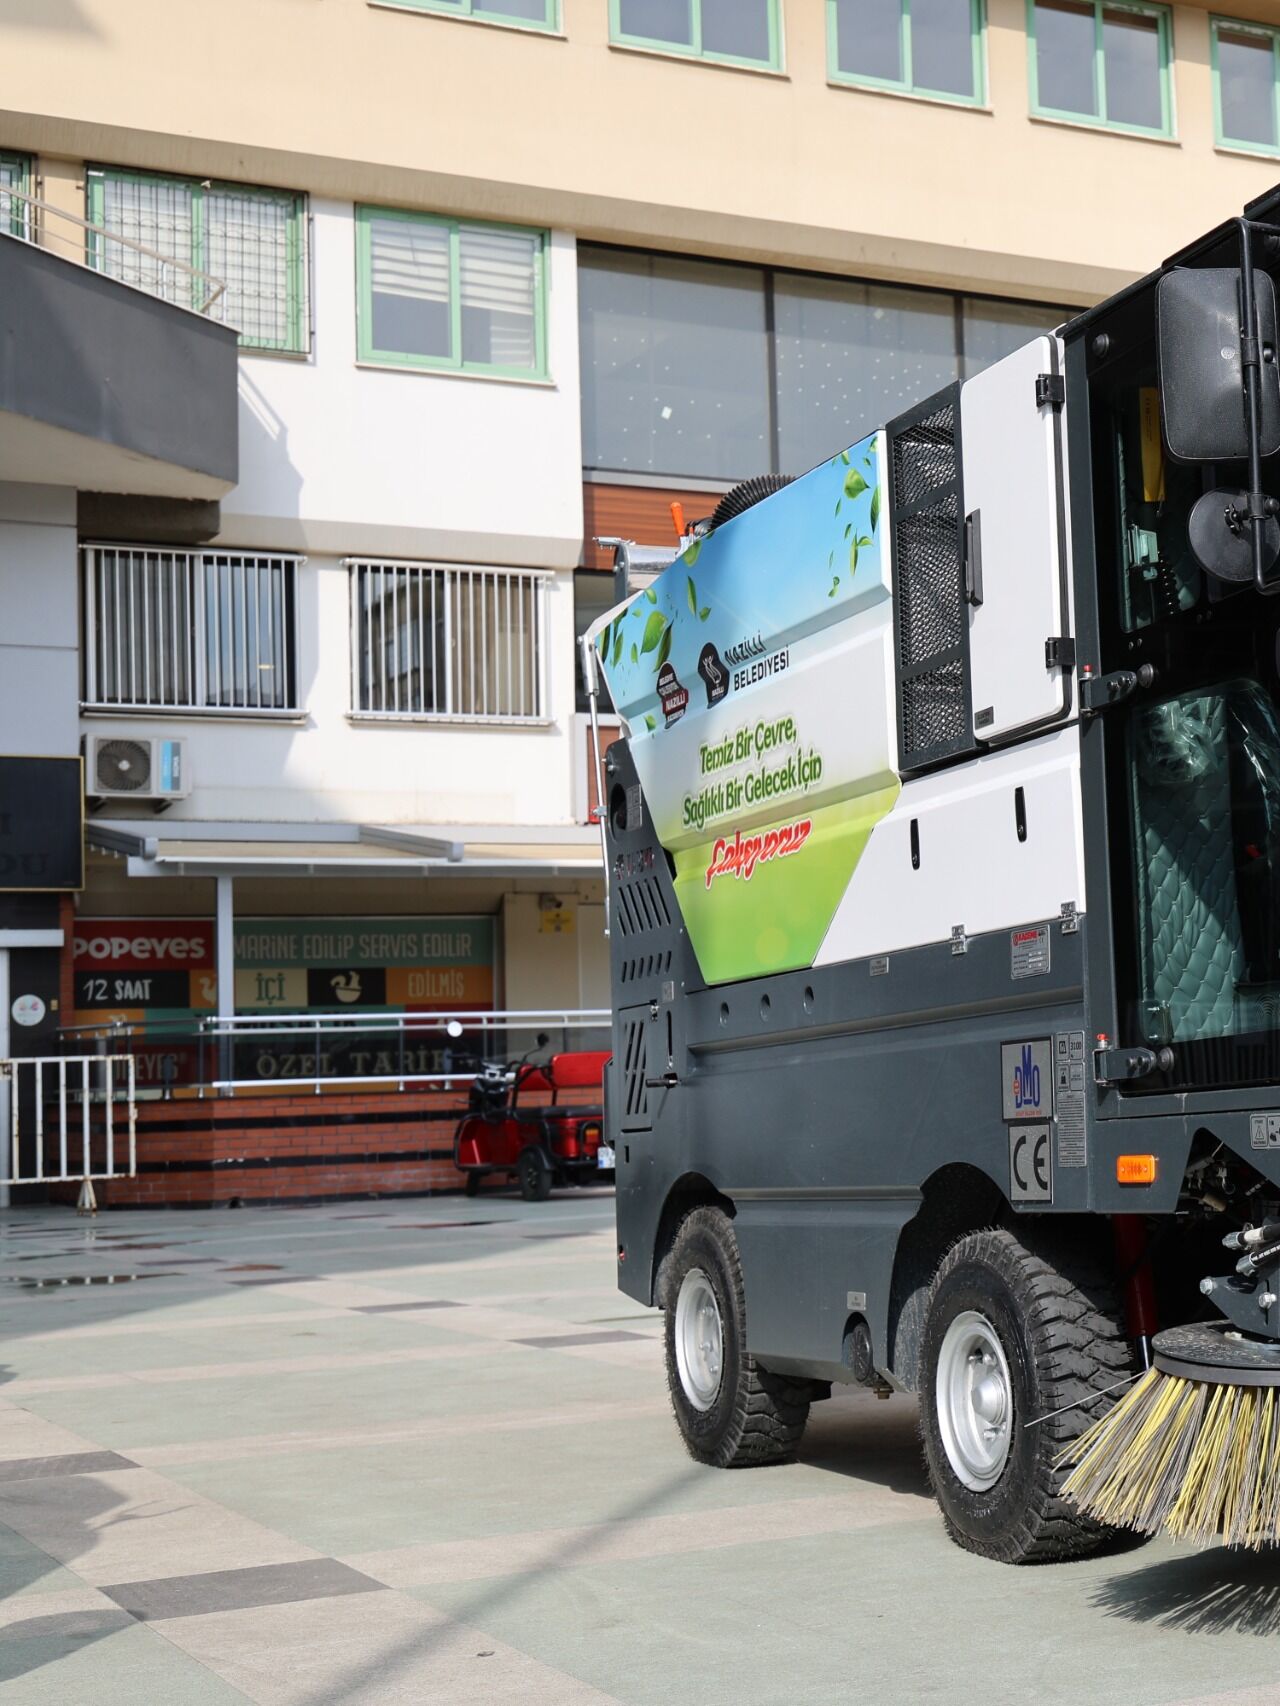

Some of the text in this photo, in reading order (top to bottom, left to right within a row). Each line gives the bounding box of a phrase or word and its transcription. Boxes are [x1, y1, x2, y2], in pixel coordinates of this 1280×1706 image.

[724, 629, 767, 667] NAZİLLİ
[733, 644, 790, 691] BELEDİYESİ
[700, 717, 797, 774] Temiz Bir Çevre,
[683, 782, 725, 828] Sağlıklı
[726, 777, 744, 810] Bir
[744, 757, 797, 802] Gelecek
[797, 747, 822, 791] İçin
[83, 978, 153, 1001] 12 SAAT
[255, 971, 286, 1005] İÇİ
[407, 968, 465, 1000] EDİLMİŞ
[256, 1050, 337, 1078] ÖZEL
[1013, 1133, 1049, 1191] CE
